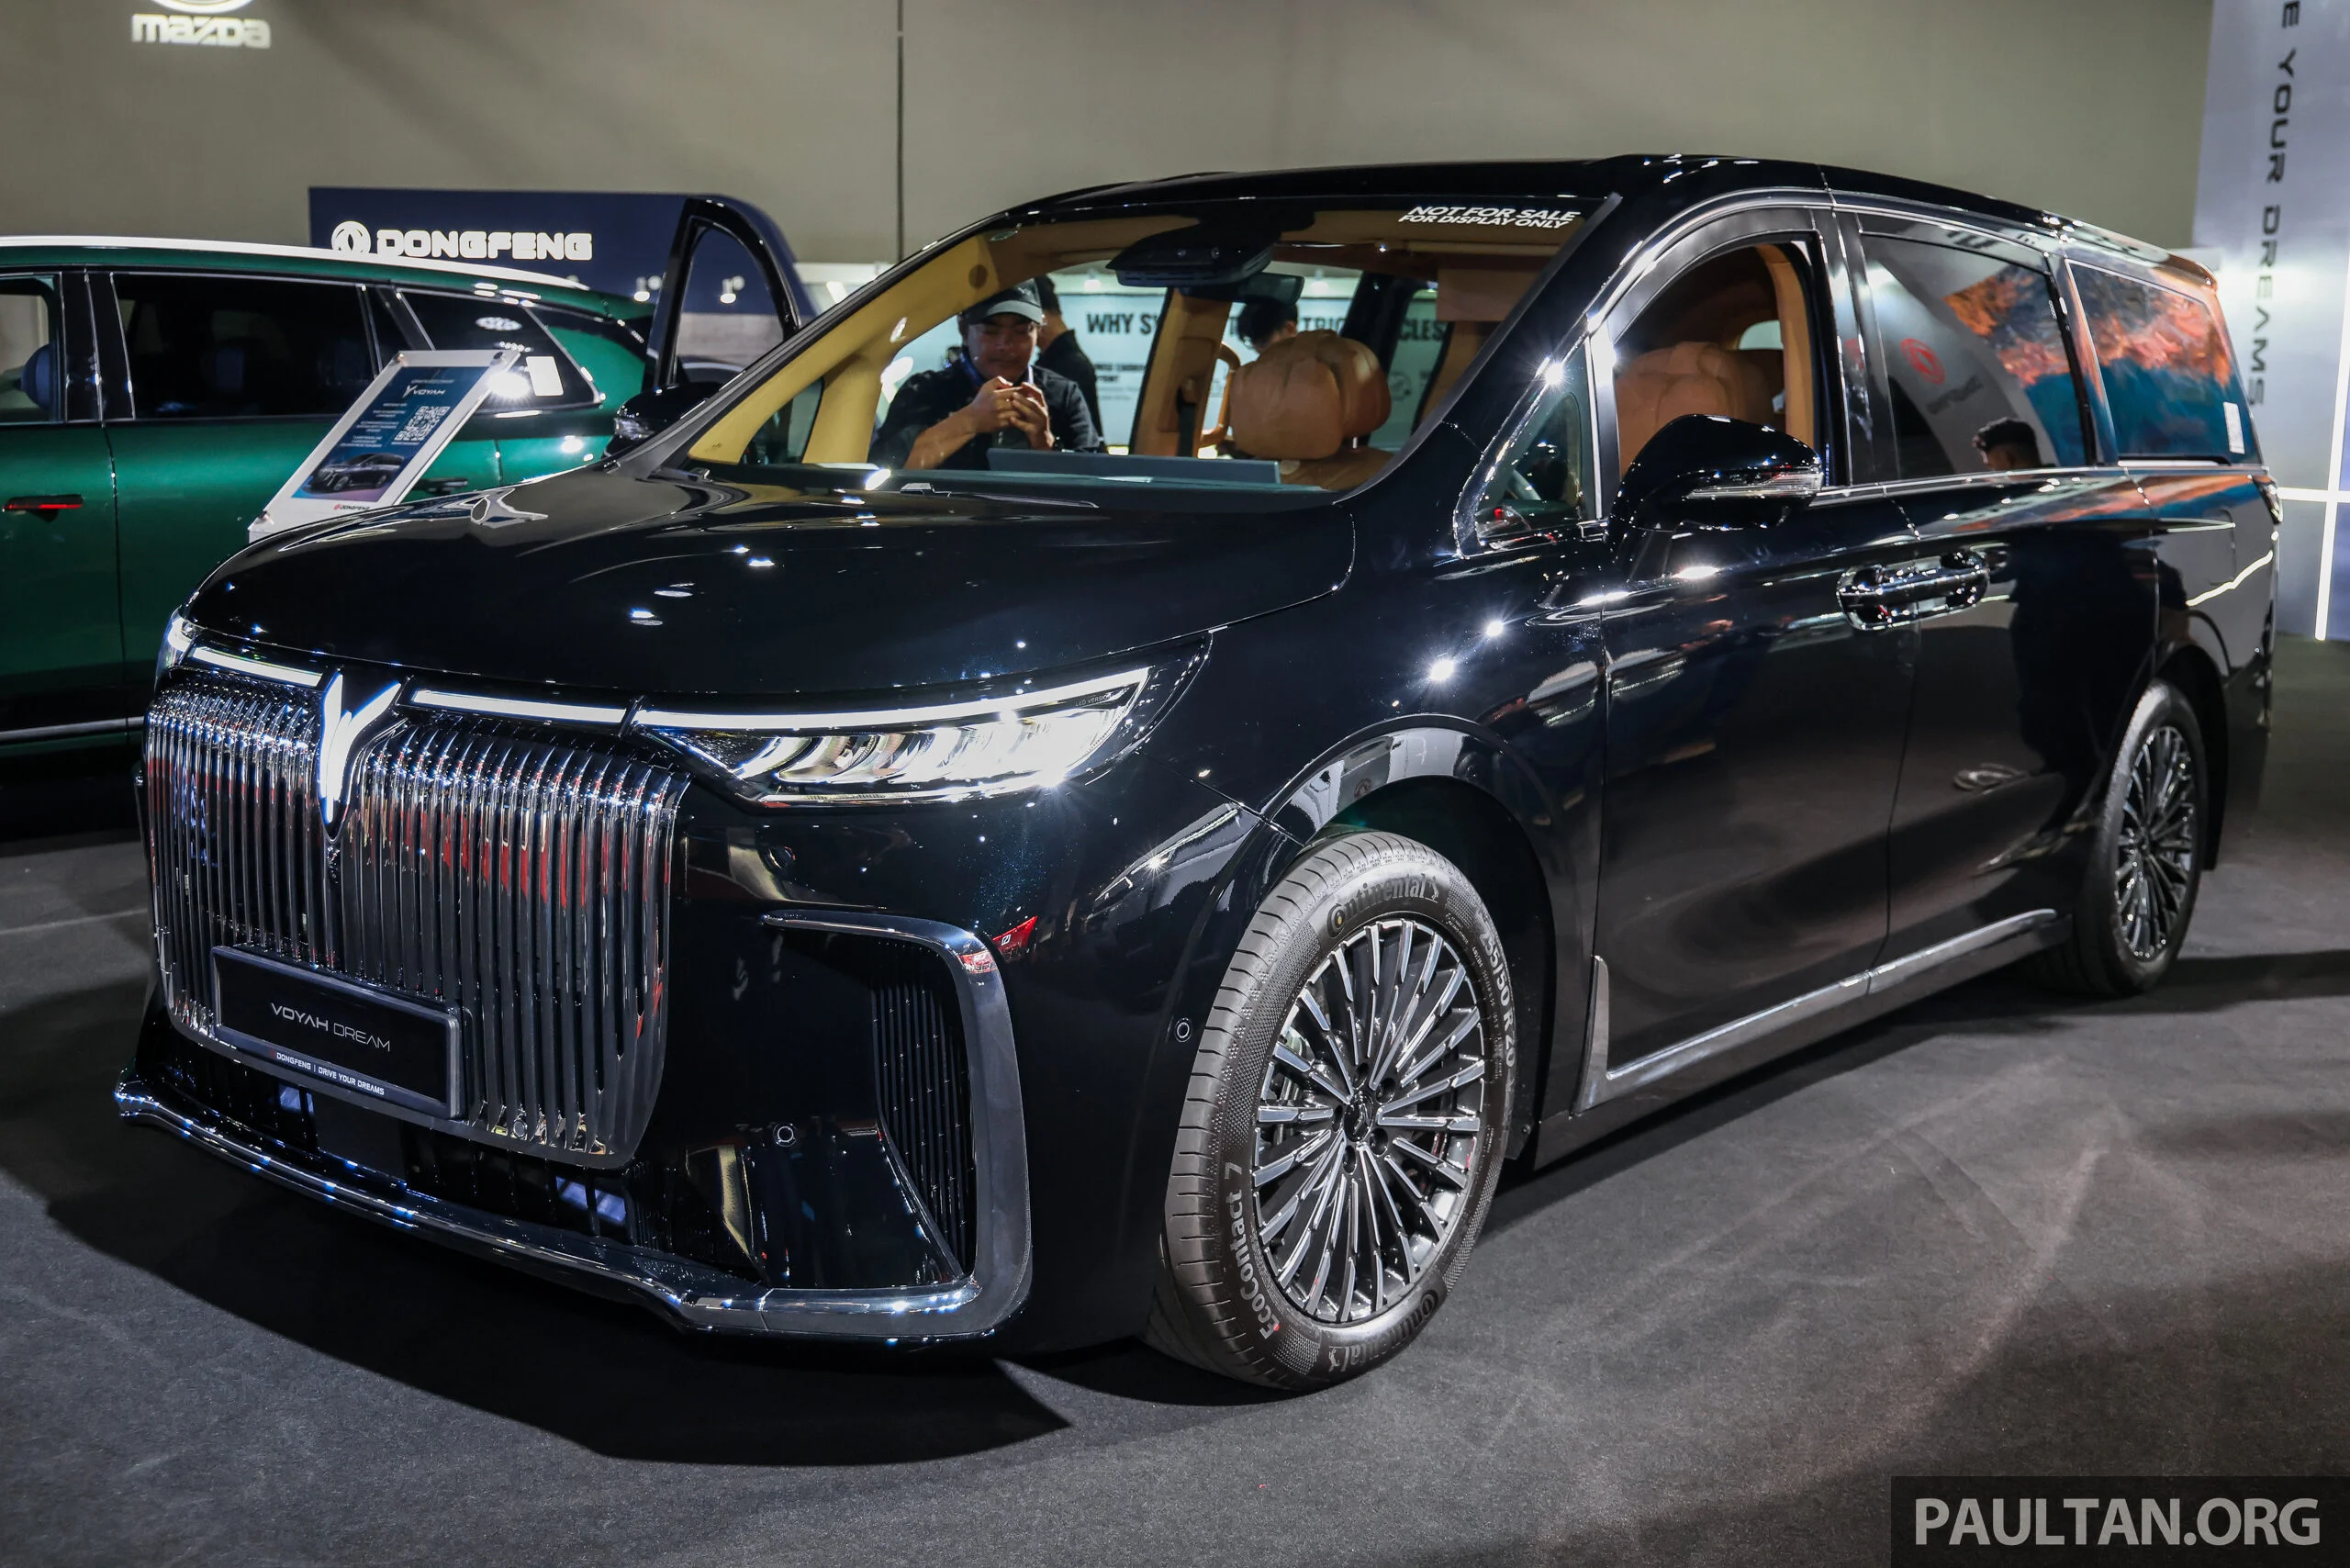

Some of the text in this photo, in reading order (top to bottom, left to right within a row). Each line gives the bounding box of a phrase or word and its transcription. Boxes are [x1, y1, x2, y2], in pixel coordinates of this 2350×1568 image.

[2266, 48, 2297, 184] YOUR
[1398, 215, 1569, 229] FOR DISPLAY ONLY
[1407, 207, 1581, 221] NOT FOR SALE
[377, 230, 593, 261] DONGFENG
[2248, 204, 2280, 406] DREAMS
[1087, 313, 1135, 334] WHY
[271, 1002, 390, 1052] VOYAH DREAM
[1503, 1010, 1515, 1032] R
[1505, 1038, 1516, 1069] 20
[276, 1052, 385, 1095] DONGFENG DRIVE YOUR DREAMS
[1225, 1161, 1280, 1340] EcoContact 7
